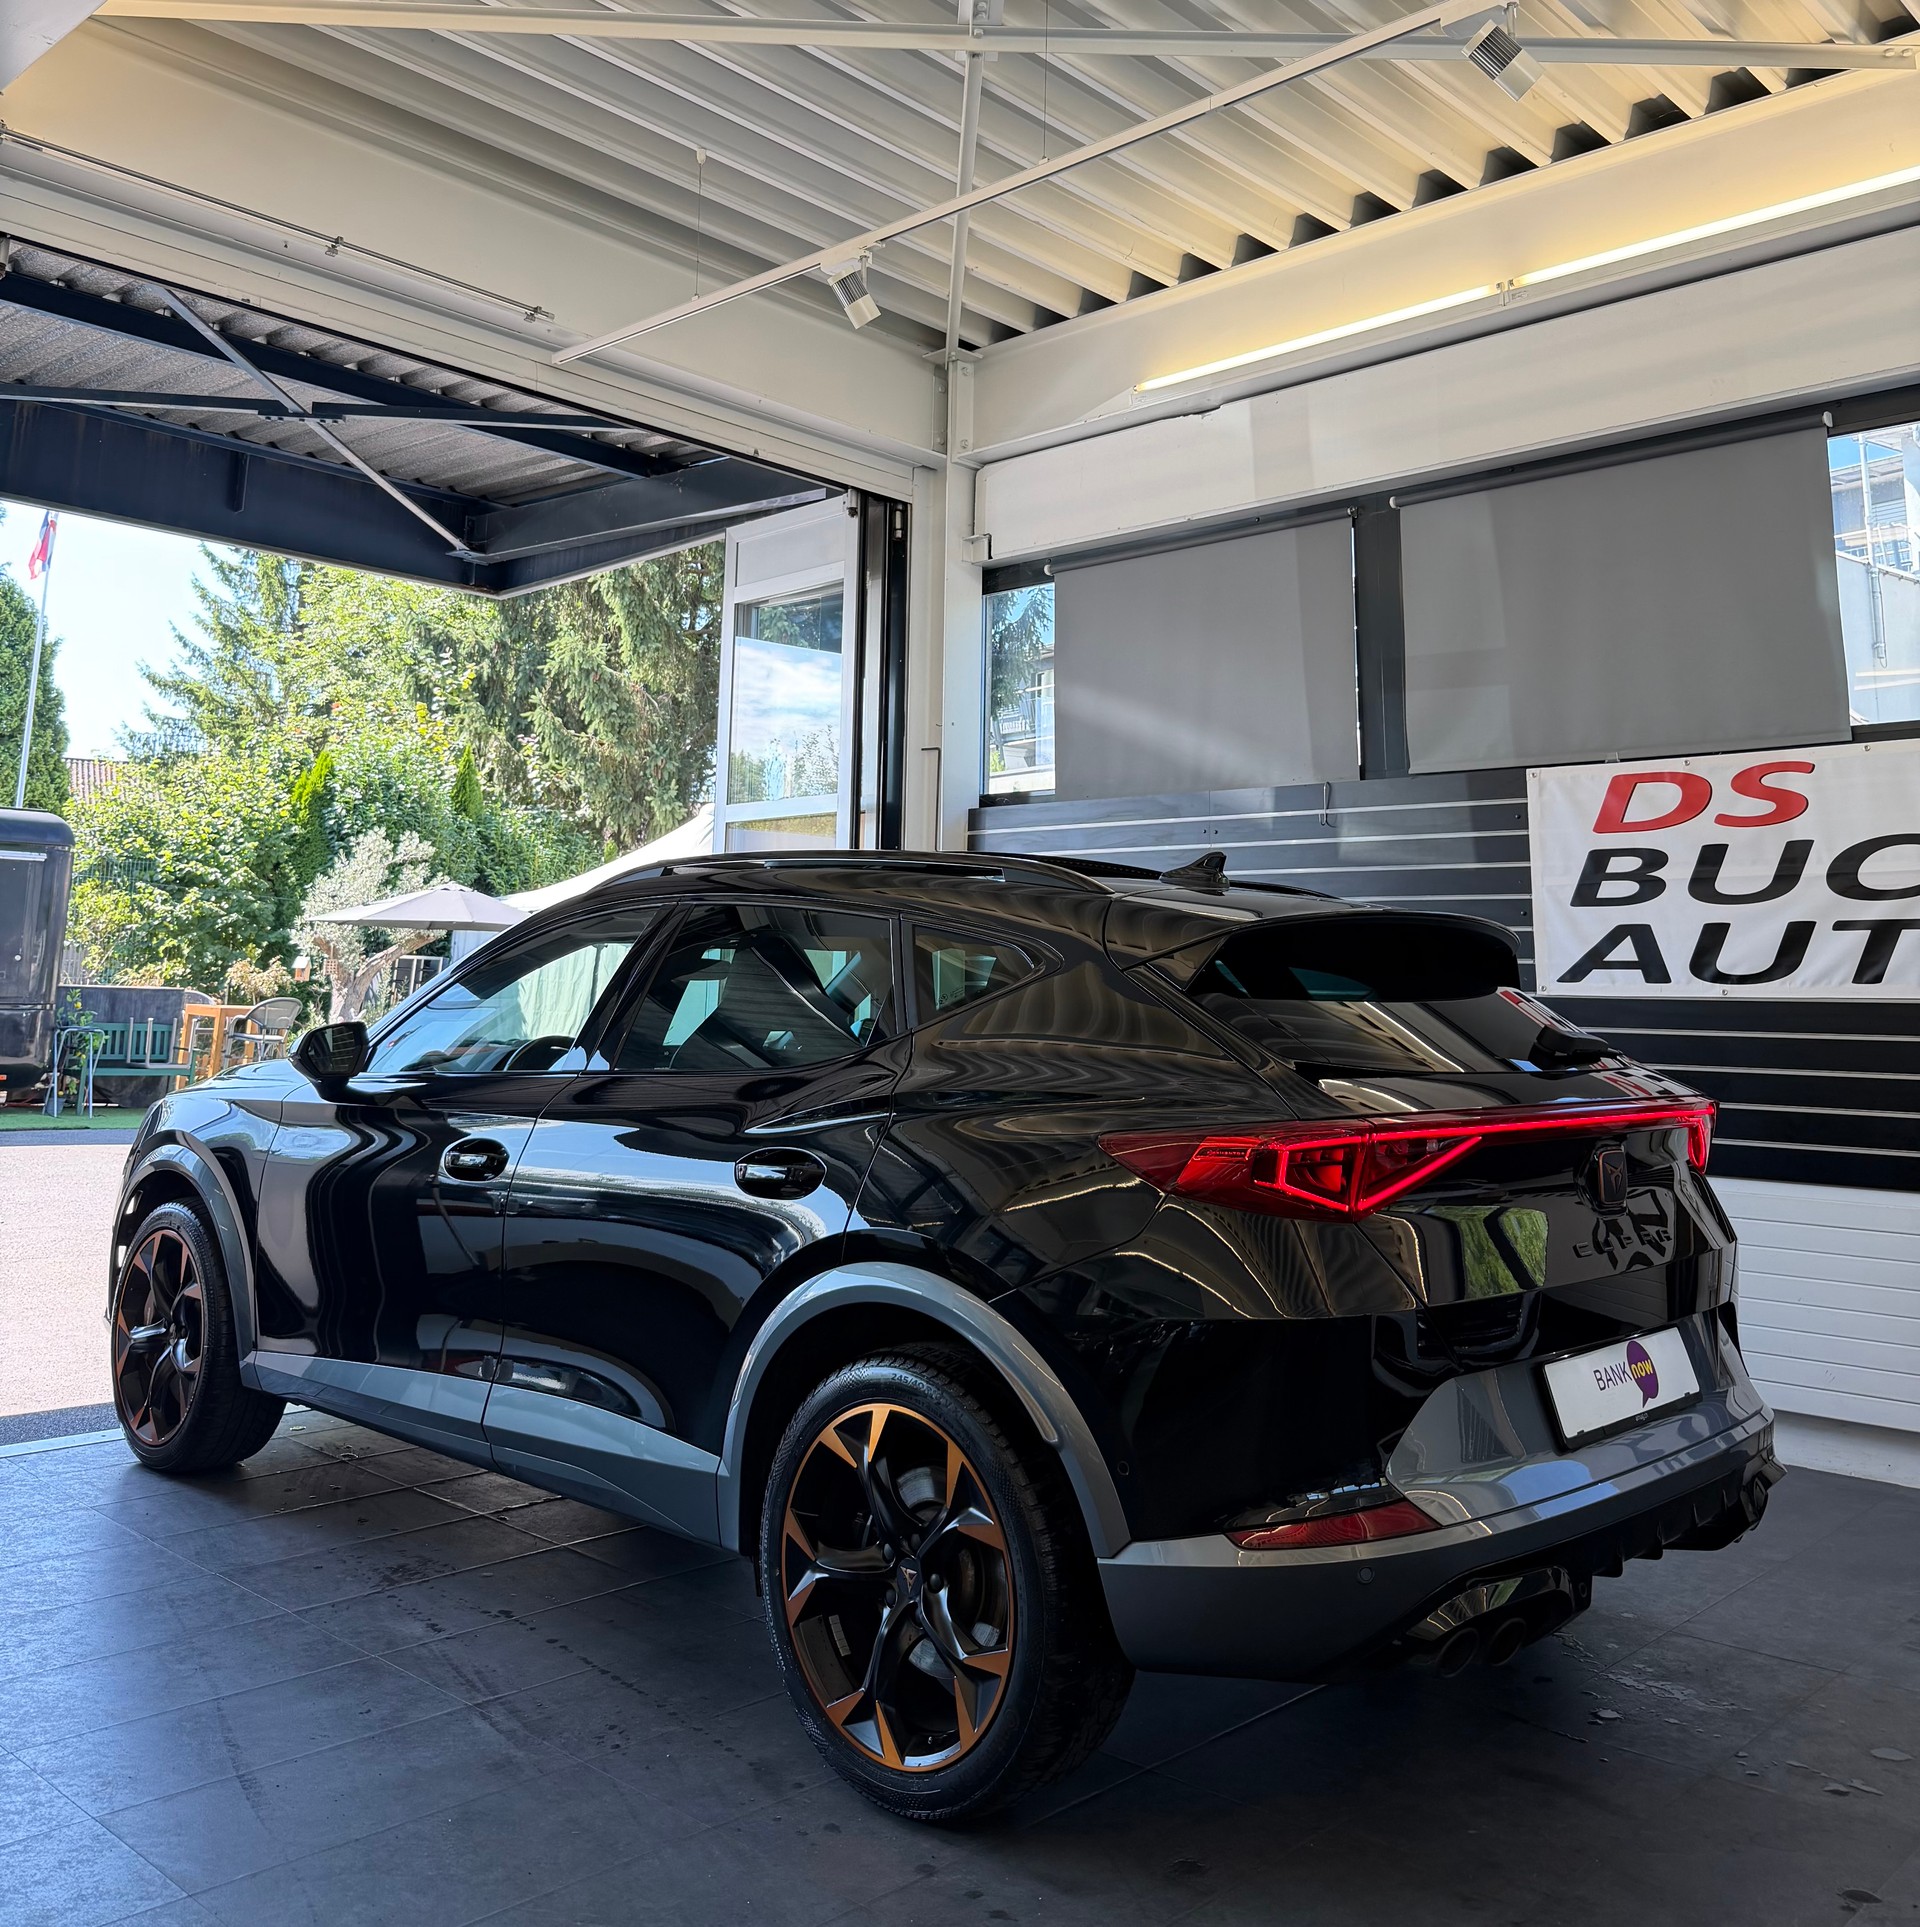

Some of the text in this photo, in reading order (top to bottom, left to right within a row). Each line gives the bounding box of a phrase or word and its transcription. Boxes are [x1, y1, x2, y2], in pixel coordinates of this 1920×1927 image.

[1592, 760, 1815, 834] DS
[1556, 919, 1920, 984] AUT
[1593, 1359, 1653, 1391] BANK now
